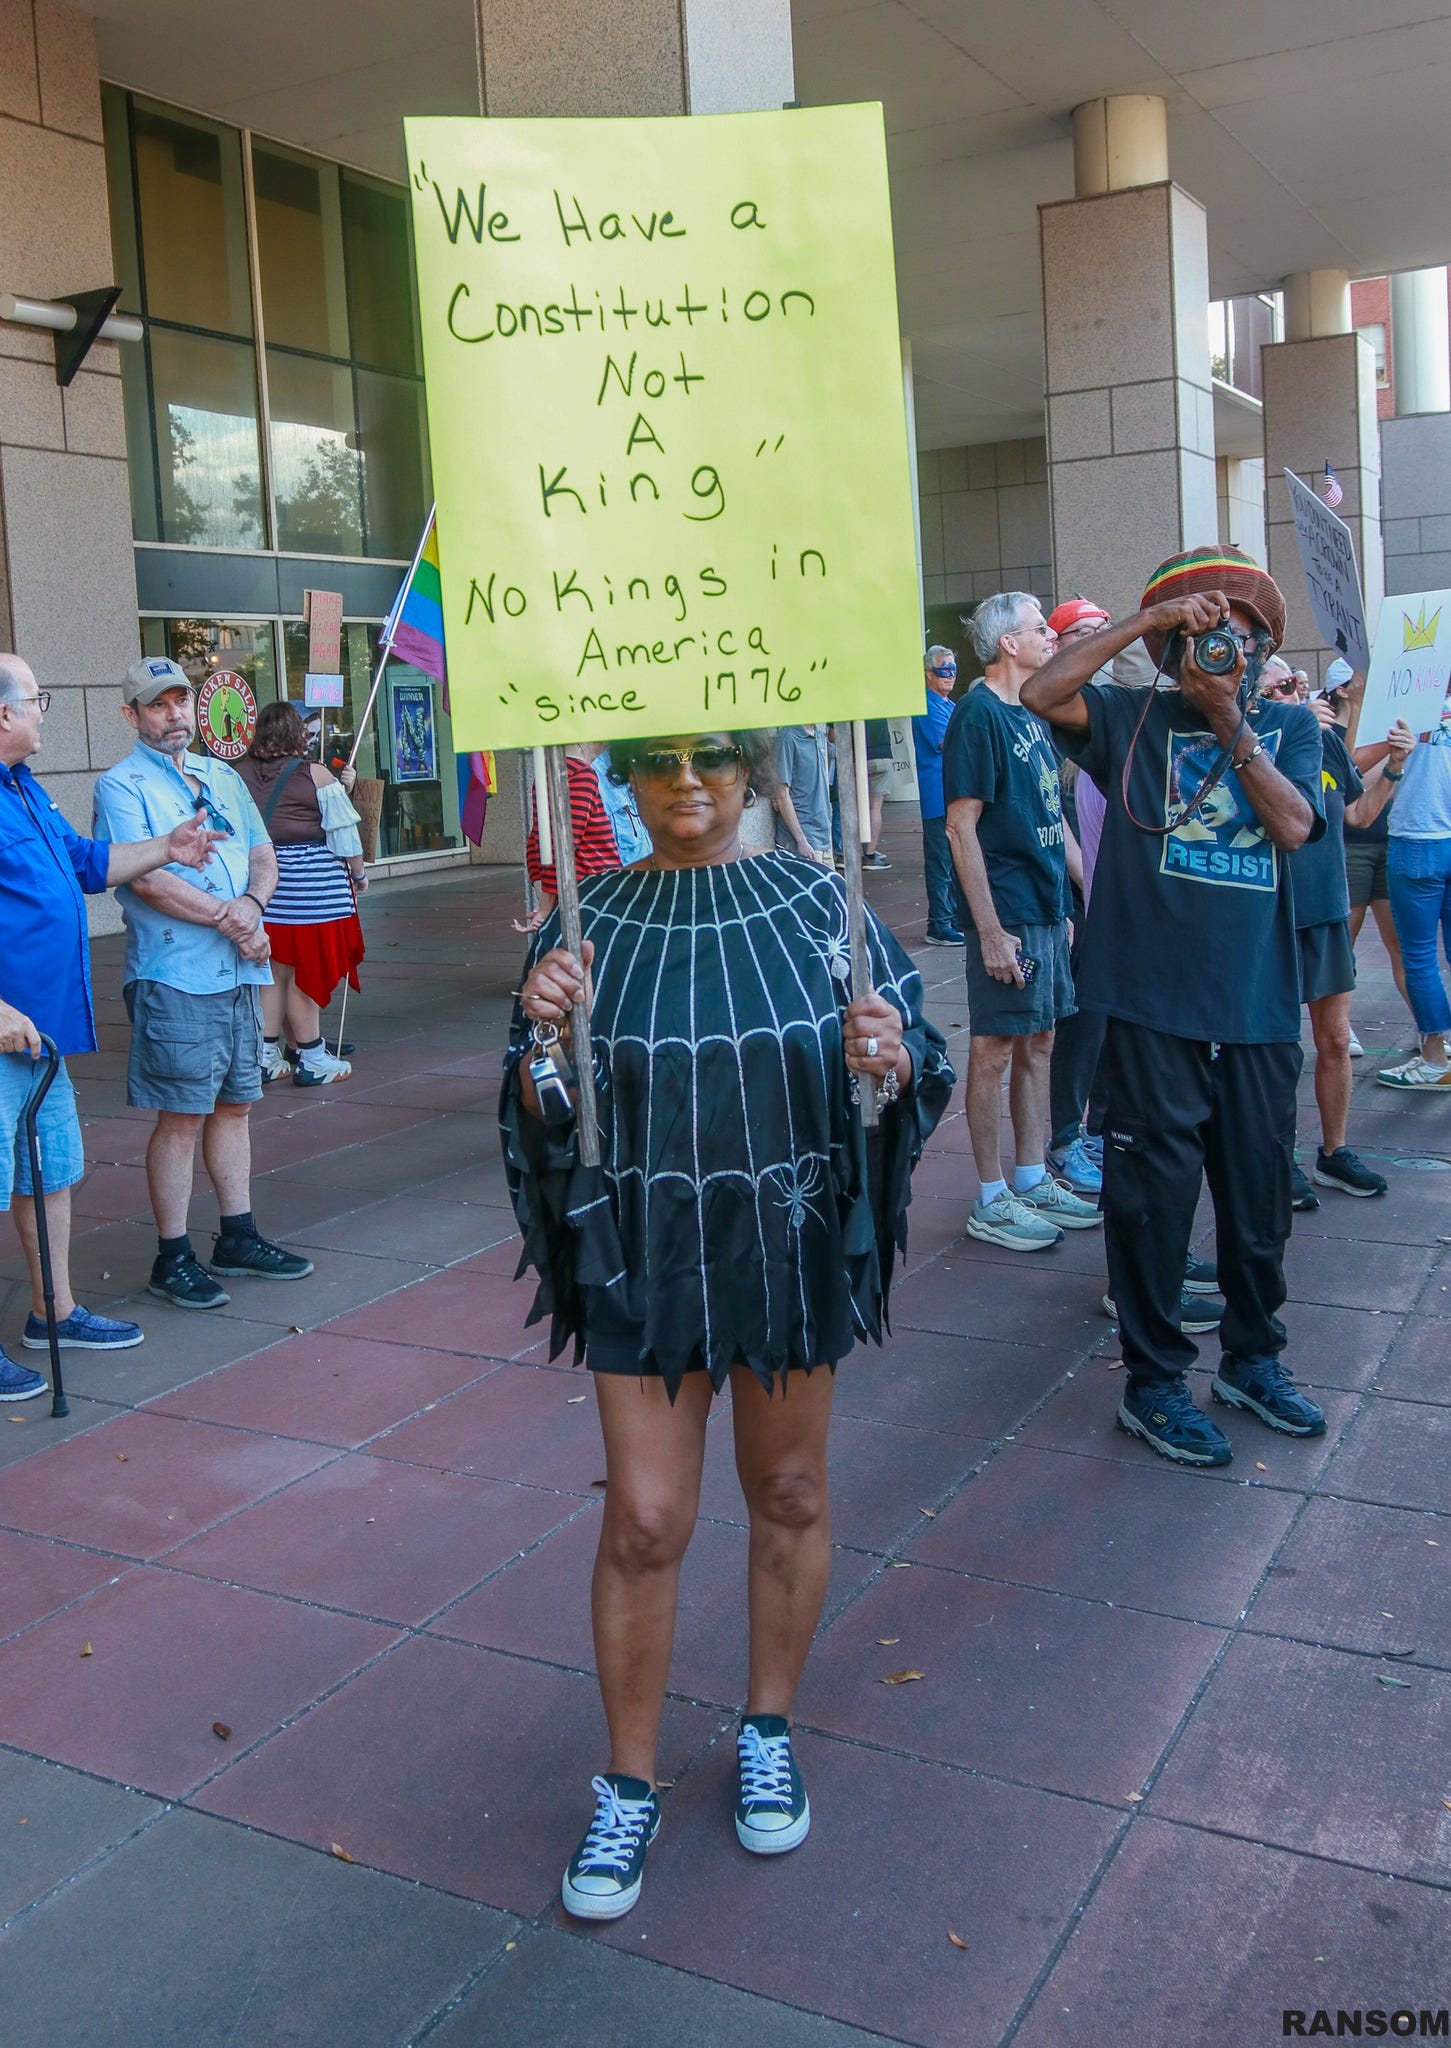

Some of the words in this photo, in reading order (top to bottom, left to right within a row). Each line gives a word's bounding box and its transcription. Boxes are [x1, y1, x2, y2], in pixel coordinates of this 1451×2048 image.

[553, 189, 687, 247] Have
[730, 201, 767, 230] a
[447, 282, 815, 344] Constitution
[597, 351, 705, 407] Not
[626, 412, 665, 456] A
[464, 572, 527, 626] No
[552, 567, 728, 622] Kings
[771, 543, 826, 581] in
[576, 626, 771, 681] America
[200, 673, 231, 727] CHICKEN
[234, 678, 256, 725] SALAD
[1386, 668, 1412, 703] NO
[213, 739, 247, 757] CHICK
[1167, 842, 1272, 880] RESIST
